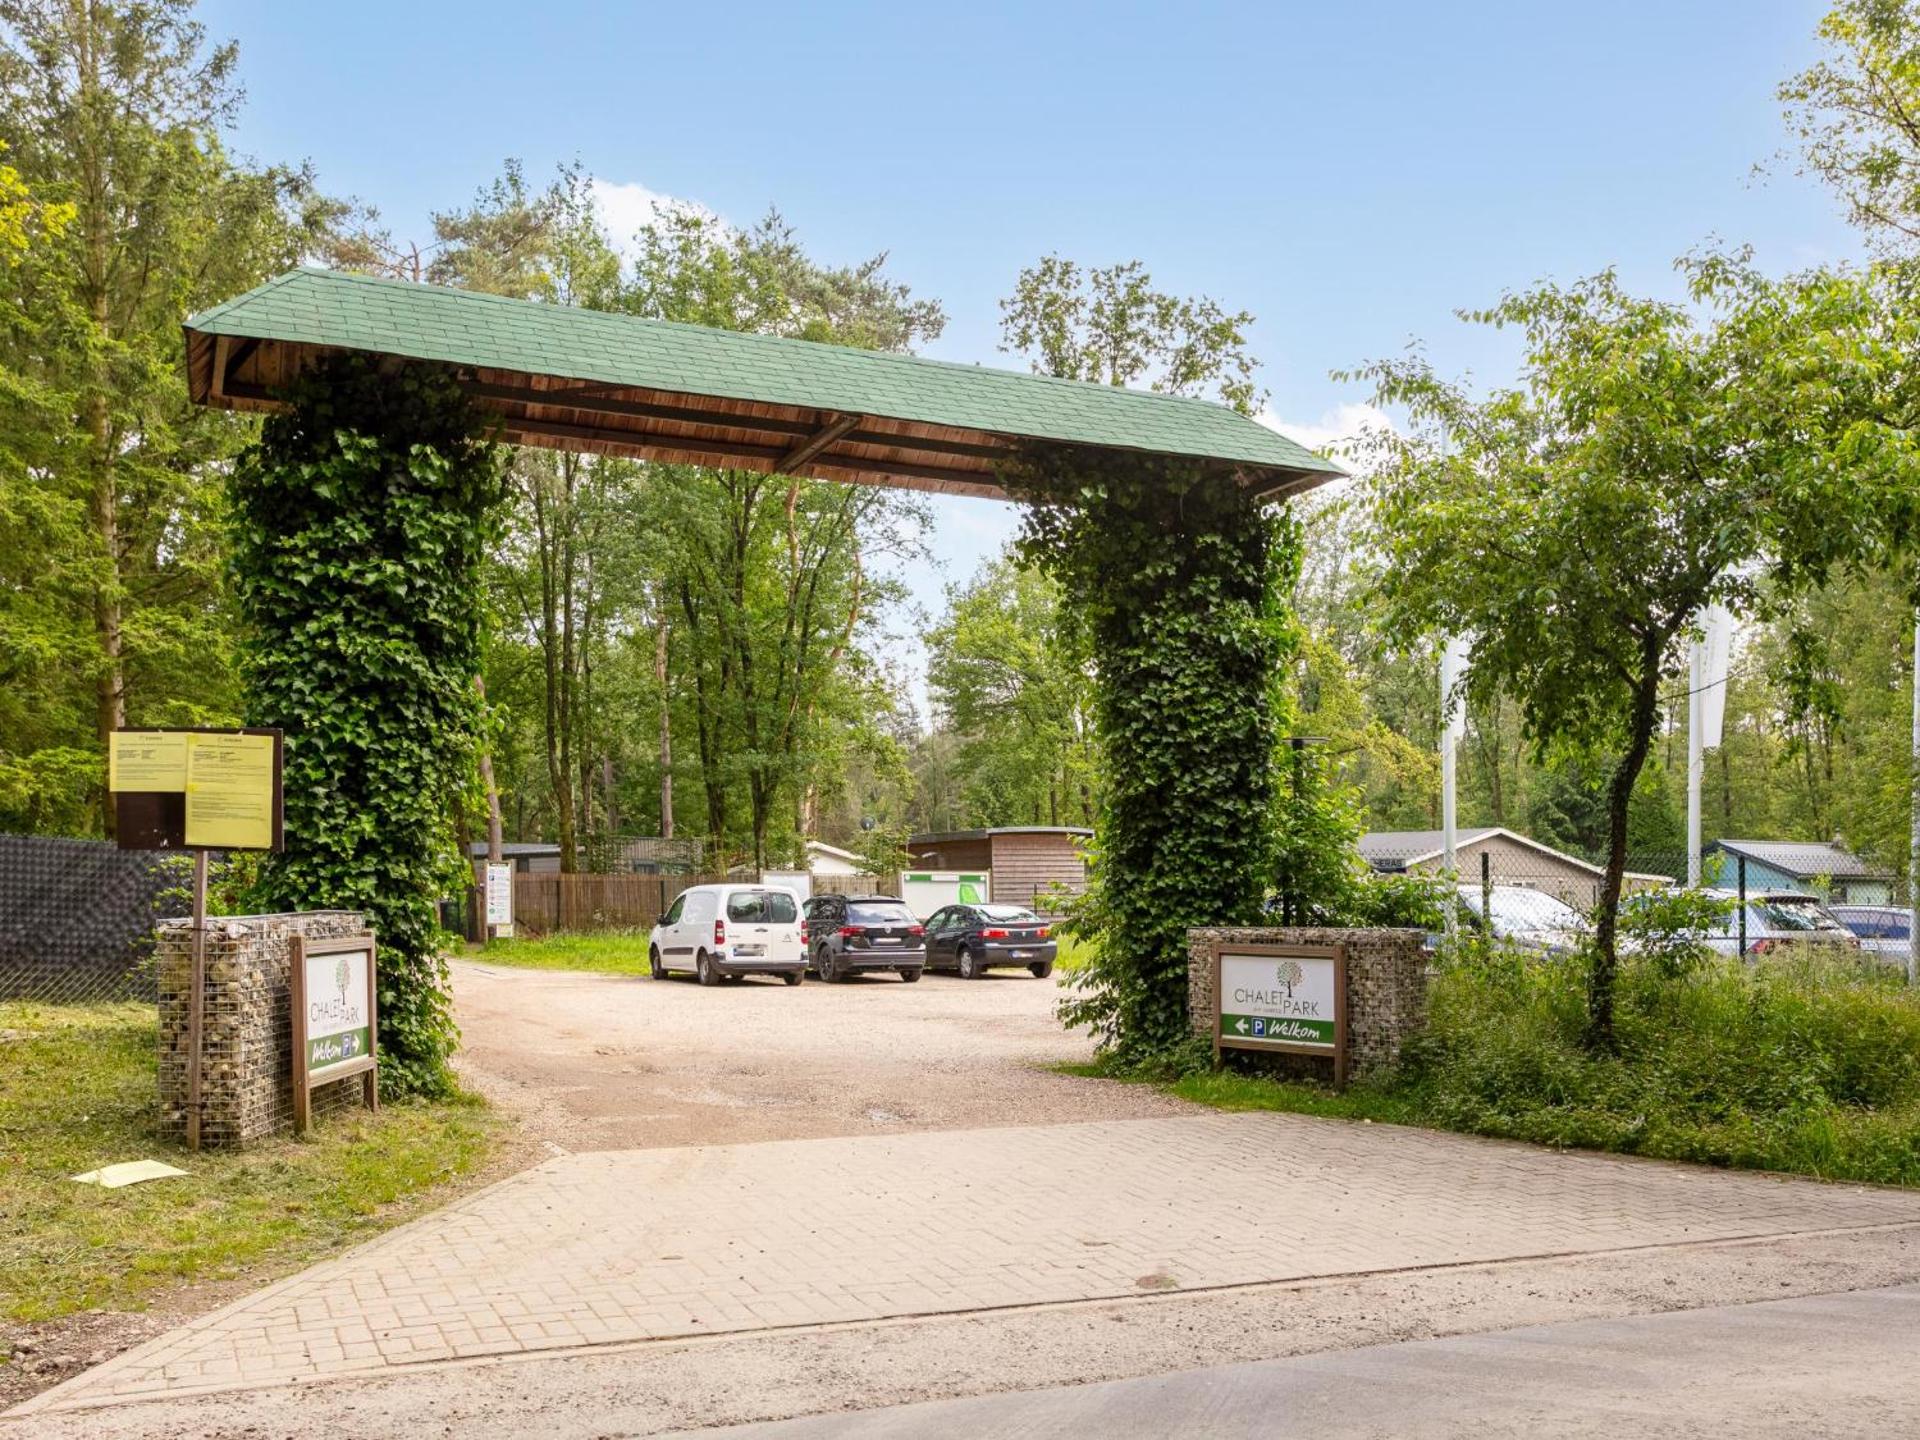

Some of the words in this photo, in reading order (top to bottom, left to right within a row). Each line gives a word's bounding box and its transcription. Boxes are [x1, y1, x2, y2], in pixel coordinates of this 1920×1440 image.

[311, 998, 341, 1022] CHALET
[1234, 988, 1284, 1006] CHALET
[1283, 1000, 1319, 1016] PARK
[1254, 1020, 1263, 1034] P
[1269, 1020, 1320, 1039] Welkom
